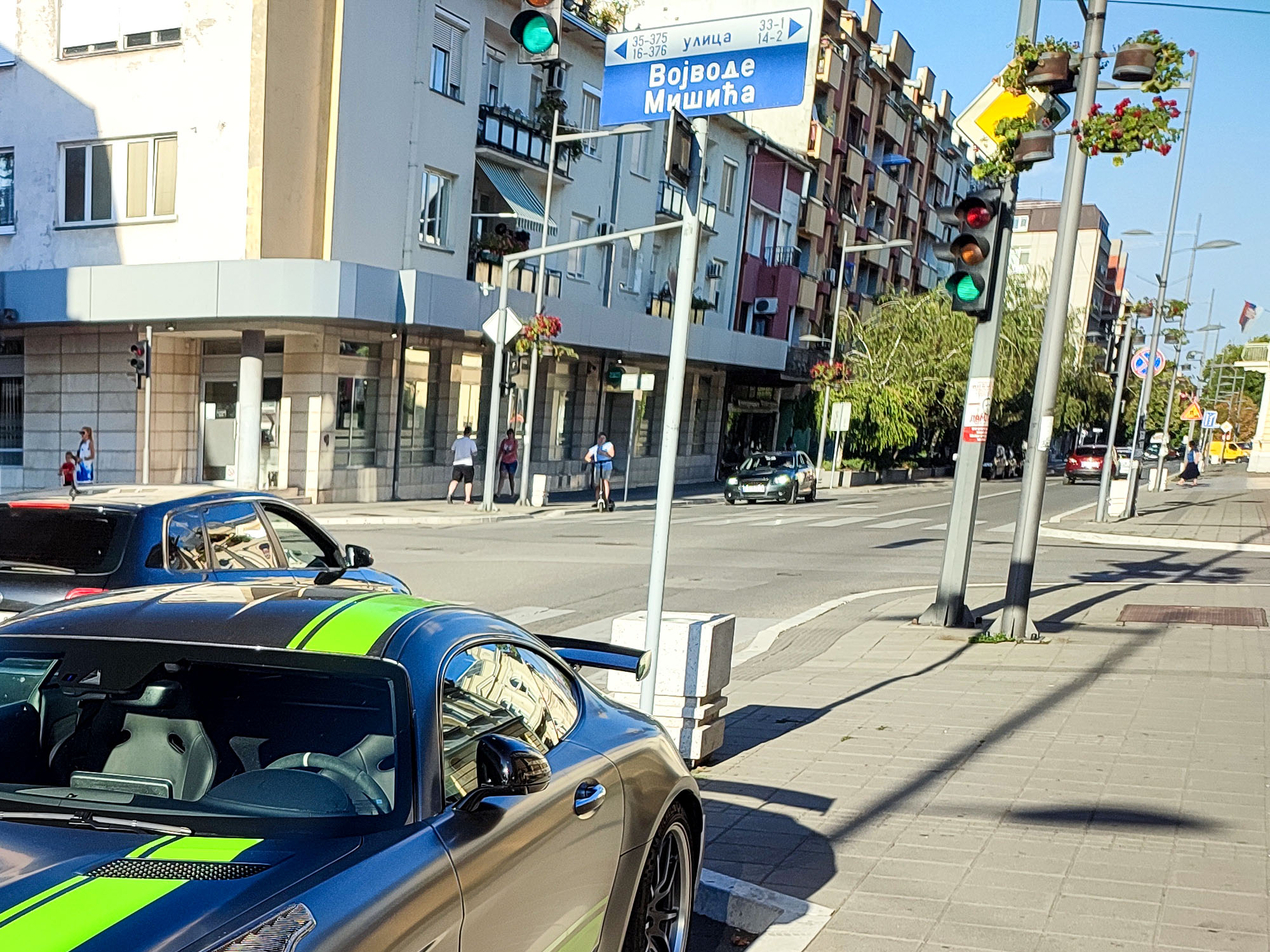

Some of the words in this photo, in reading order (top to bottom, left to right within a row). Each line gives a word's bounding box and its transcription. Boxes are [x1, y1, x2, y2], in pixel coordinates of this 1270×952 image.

[759, 17, 785, 32] 33-1
[632, 32, 668, 48] 35-375
[683, 32, 732, 52] улица
[758, 30, 783, 44] 14-2
[633, 44, 667, 60] 16-376
[649, 58, 756, 91] Војводе
[644, 81, 756, 115] Мишића
